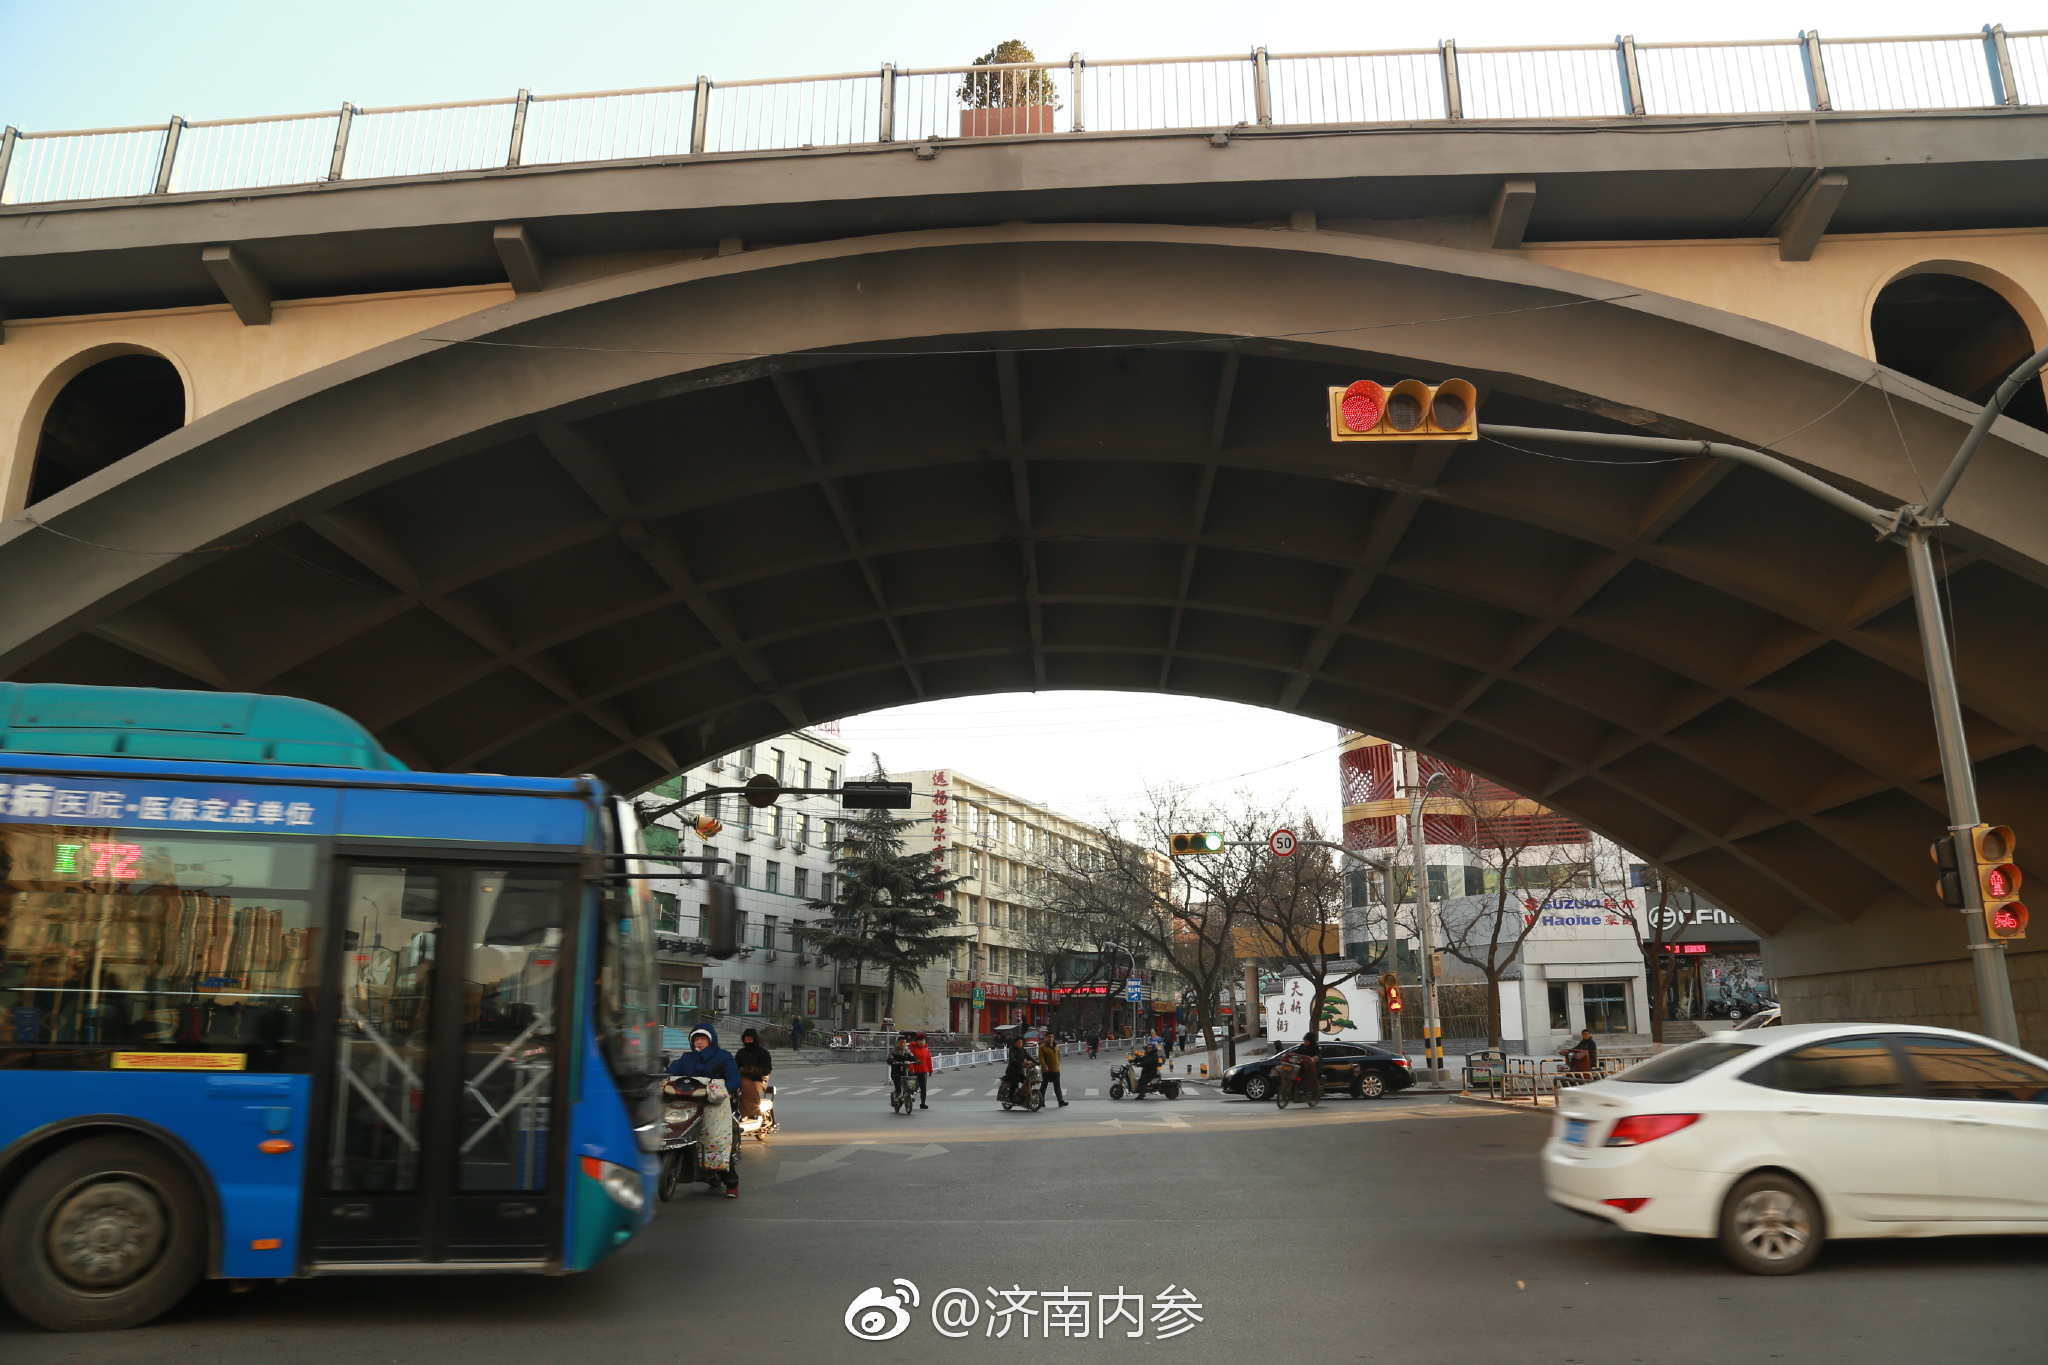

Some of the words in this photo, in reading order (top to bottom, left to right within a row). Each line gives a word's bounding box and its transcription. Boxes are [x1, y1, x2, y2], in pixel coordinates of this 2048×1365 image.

[1276, 837, 1292, 849] 50
[1542, 914, 1602, 926] Haojue
[1678, 908, 1741, 925] CFM
[976, 990, 984, 998] P
